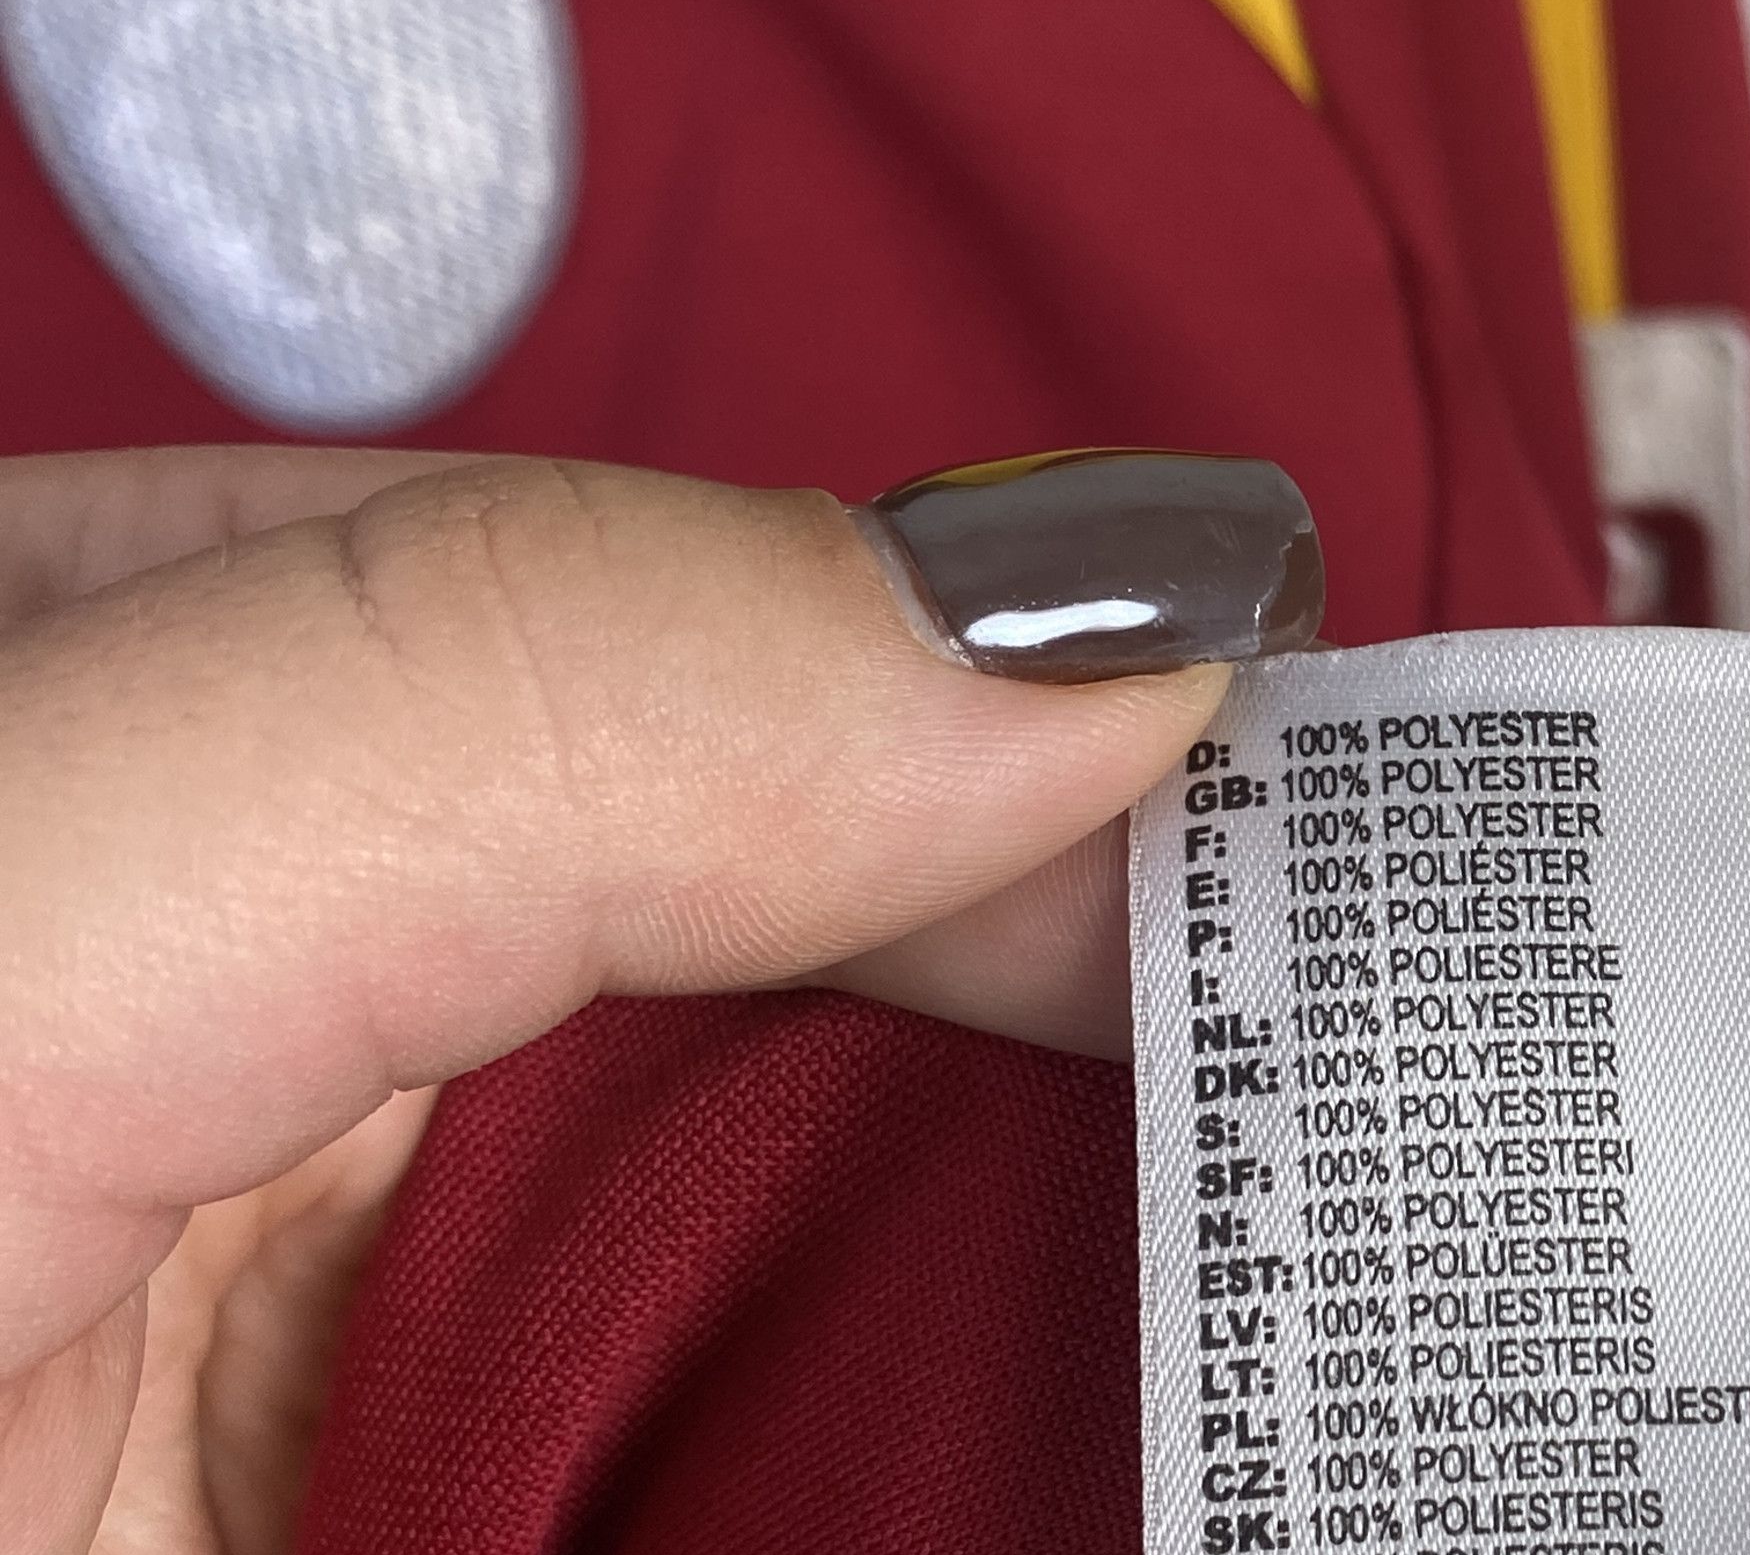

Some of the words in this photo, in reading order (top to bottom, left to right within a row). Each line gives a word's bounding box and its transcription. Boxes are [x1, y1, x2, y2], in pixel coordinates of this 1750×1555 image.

[1186, 740, 1230, 774] D:
[1281, 721, 1368, 757] 100%
[1379, 711, 1598, 750] POLYESTER
[1185, 776, 1267, 815] GB:
[1283, 764, 1369, 801] 100%
[1382, 756, 1600, 793] POLYESTER
[1186, 826, 1225, 862] F:
[1284, 809, 1371, 848] 100%
[1384, 802, 1603, 839] POLYESTER
[1187, 872, 1229, 910] E:
[1285, 856, 1372, 895] 100%
[1386, 842, 1590, 887] POLIÉSTER
[1188, 920, 1232, 957] P:
[1288, 902, 1374, 943] 100%
[1388, 889, 1593, 935] POLIÉSTER
[1191, 970, 1219, 1006] I:
[1289, 951, 1378, 992] 100%
[1391, 944, 1622, 984] POLIESTERE
[1193, 1014, 1271, 1054] NL:
[1292, 999, 1381, 1040] 100%
[1393, 992, 1614, 1032] POLYESTER
[1195, 1059, 1279, 1102] DK:
[1294, 1050, 1383, 1089] 100%
[1396, 1041, 1617, 1081] POLYESTER
[1196, 1113, 1239, 1150] S:
[1296, 1099, 1386, 1138] 100%
[1400, 1088, 1620, 1130] POLYESTER
[1197, 1158, 1272, 1199] SF:
[1300, 1148, 1389, 1188] 100%
[1402, 1139, 1633, 1180] POLYESTERI
[1199, 1211, 1247, 1249] N:
[1302, 1198, 1391, 1238] 100%
[1405, 1188, 1626, 1230] POLYESTER
[1199, 1256, 1293, 1299] EST:
[1304, 1247, 1393, 1288] 100%
[1407, 1231, 1632, 1280] POLÜESTER
[1200, 1307, 1275, 1350] LV:
[1305, 1297, 1395, 1339] 100%
[1409, 1287, 1653, 1331] POLIESTERIS
[1201, 1359, 1274, 1401] LT:
[1307, 1347, 1396, 1389] 100%
[1411, 1336, 1655, 1382] POLIESTERIS
[1202, 1411, 1279, 1452] PL:
[1308, 1399, 1398, 1441] 100%
[1411, 1383, 1577, 1433] WŁÓKNO
[1203, 1460, 1286, 1502] CZ:
[1309, 1450, 1400, 1492] 100%
[1414, 1438, 1640, 1485] POLYESTER
[1203, 1512, 1289, 1554] SK:
[1311, 1501, 1401, 1545] 100%
[1416, 1490, 1663, 1537] POLIESTERIS
